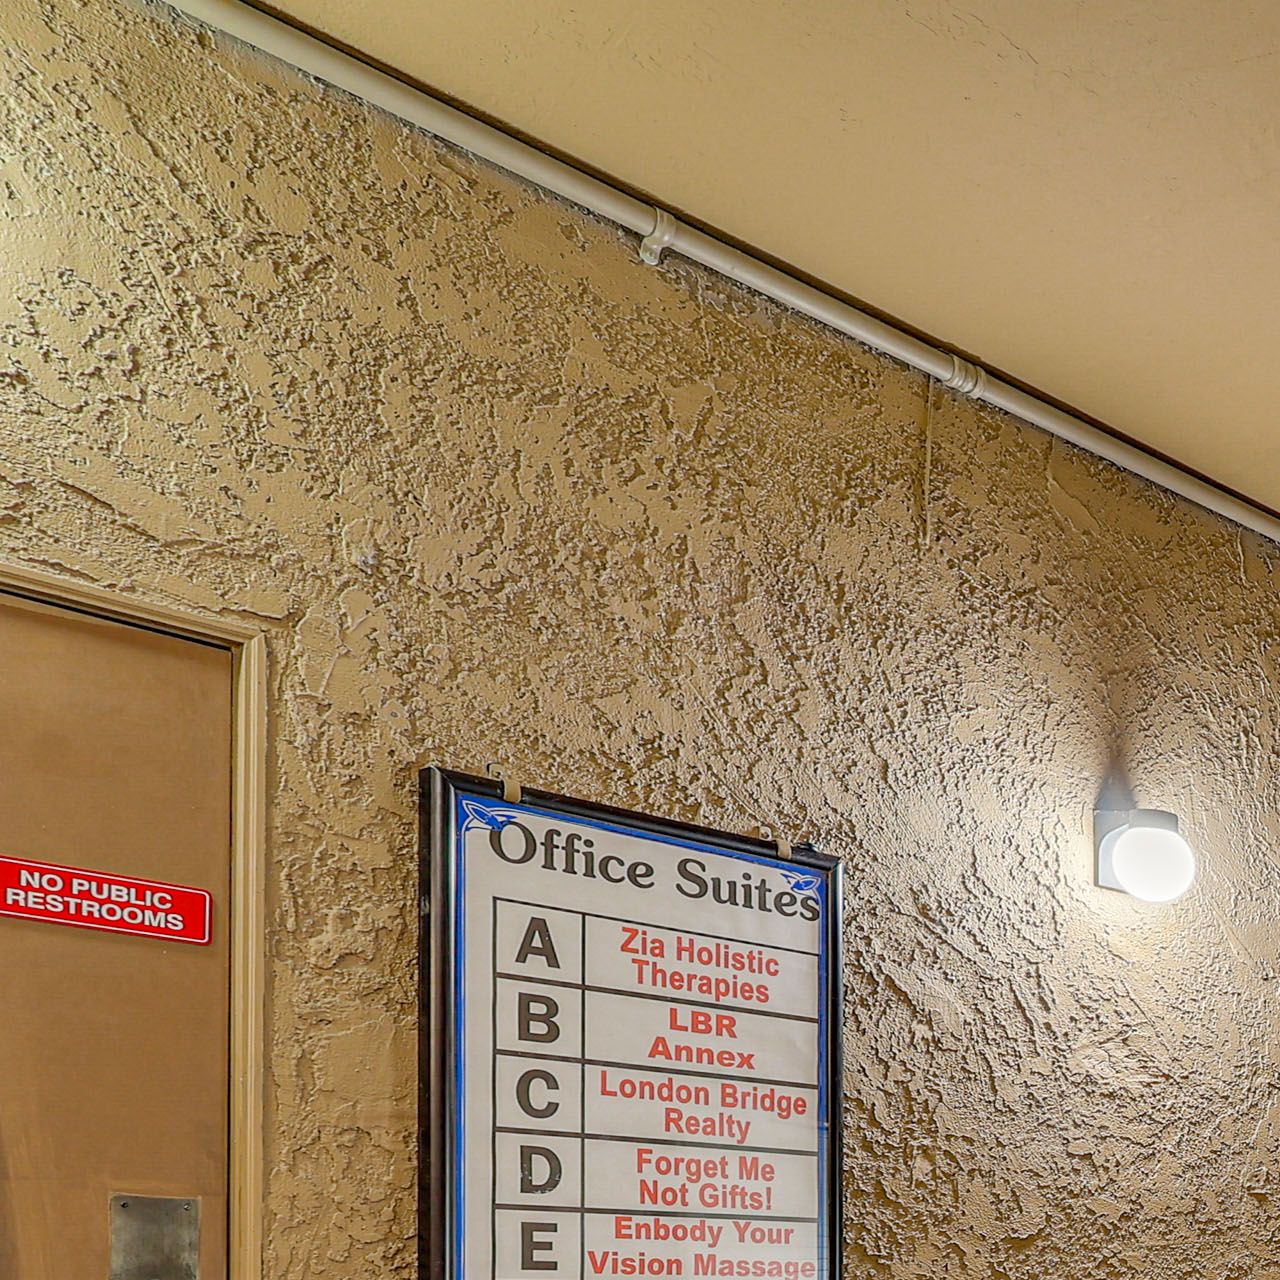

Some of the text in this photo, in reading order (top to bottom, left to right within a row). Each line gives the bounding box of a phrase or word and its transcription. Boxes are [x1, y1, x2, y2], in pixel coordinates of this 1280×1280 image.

[19, 869, 173, 910] NO PUBLIC
[489, 820, 821, 922] Office Suites
[5, 887, 184, 931] RESTROOMS
[515, 916, 561, 969] A
[620, 926, 780, 977] Zia Holistic
[631, 957, 770, 1004] Therapies
[517, 991, 561, 1044] B
[669, 1007, 738, 1039] LBR
[647, 1036, 756, 1070] Annex
[515, 1068, 560, 1120] C
[600, 1070, 808, 1120] London Bridge
[664, 1107, 751, 1145] Realty
[519, 1144, 562, 1195] D
[636, 1148, 776, 1184] Forget Me
[639, 1179, 773, 1211] Not Gifts!
[520, 1221, 558, 1271] E
[614, 1216, 795, 1248] Enbody Your
[587, 1250, 683, 1275] Vision
